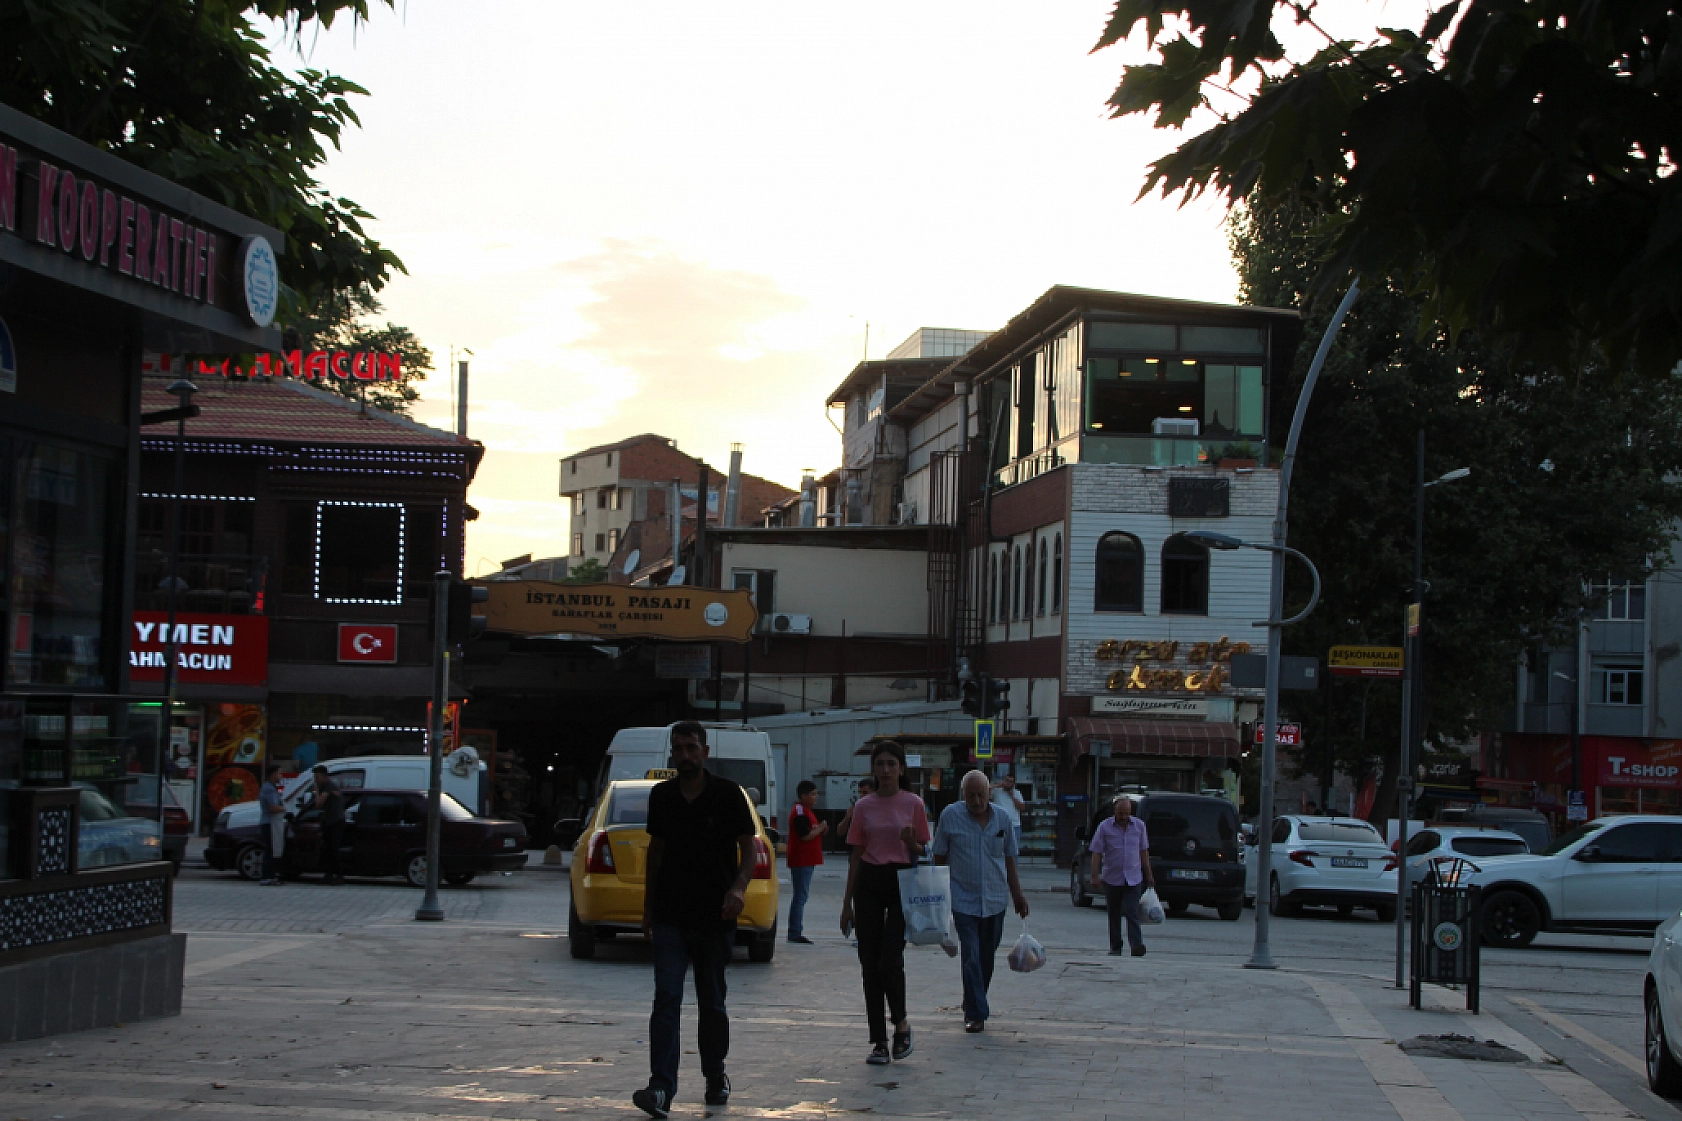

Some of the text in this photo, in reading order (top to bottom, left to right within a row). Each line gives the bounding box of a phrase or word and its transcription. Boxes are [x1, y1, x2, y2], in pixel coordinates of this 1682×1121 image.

[37, 159, 216, 304] KOOPERATİFİ
[526, 590, 691, 609] İSTANBUL PASAJI
[1332, 649, 1400, 660] BEŞKONAKLAR
[1107, 664, 1230, 692] ekmek
[1607, 756, 1680, 777] T-SHOP
